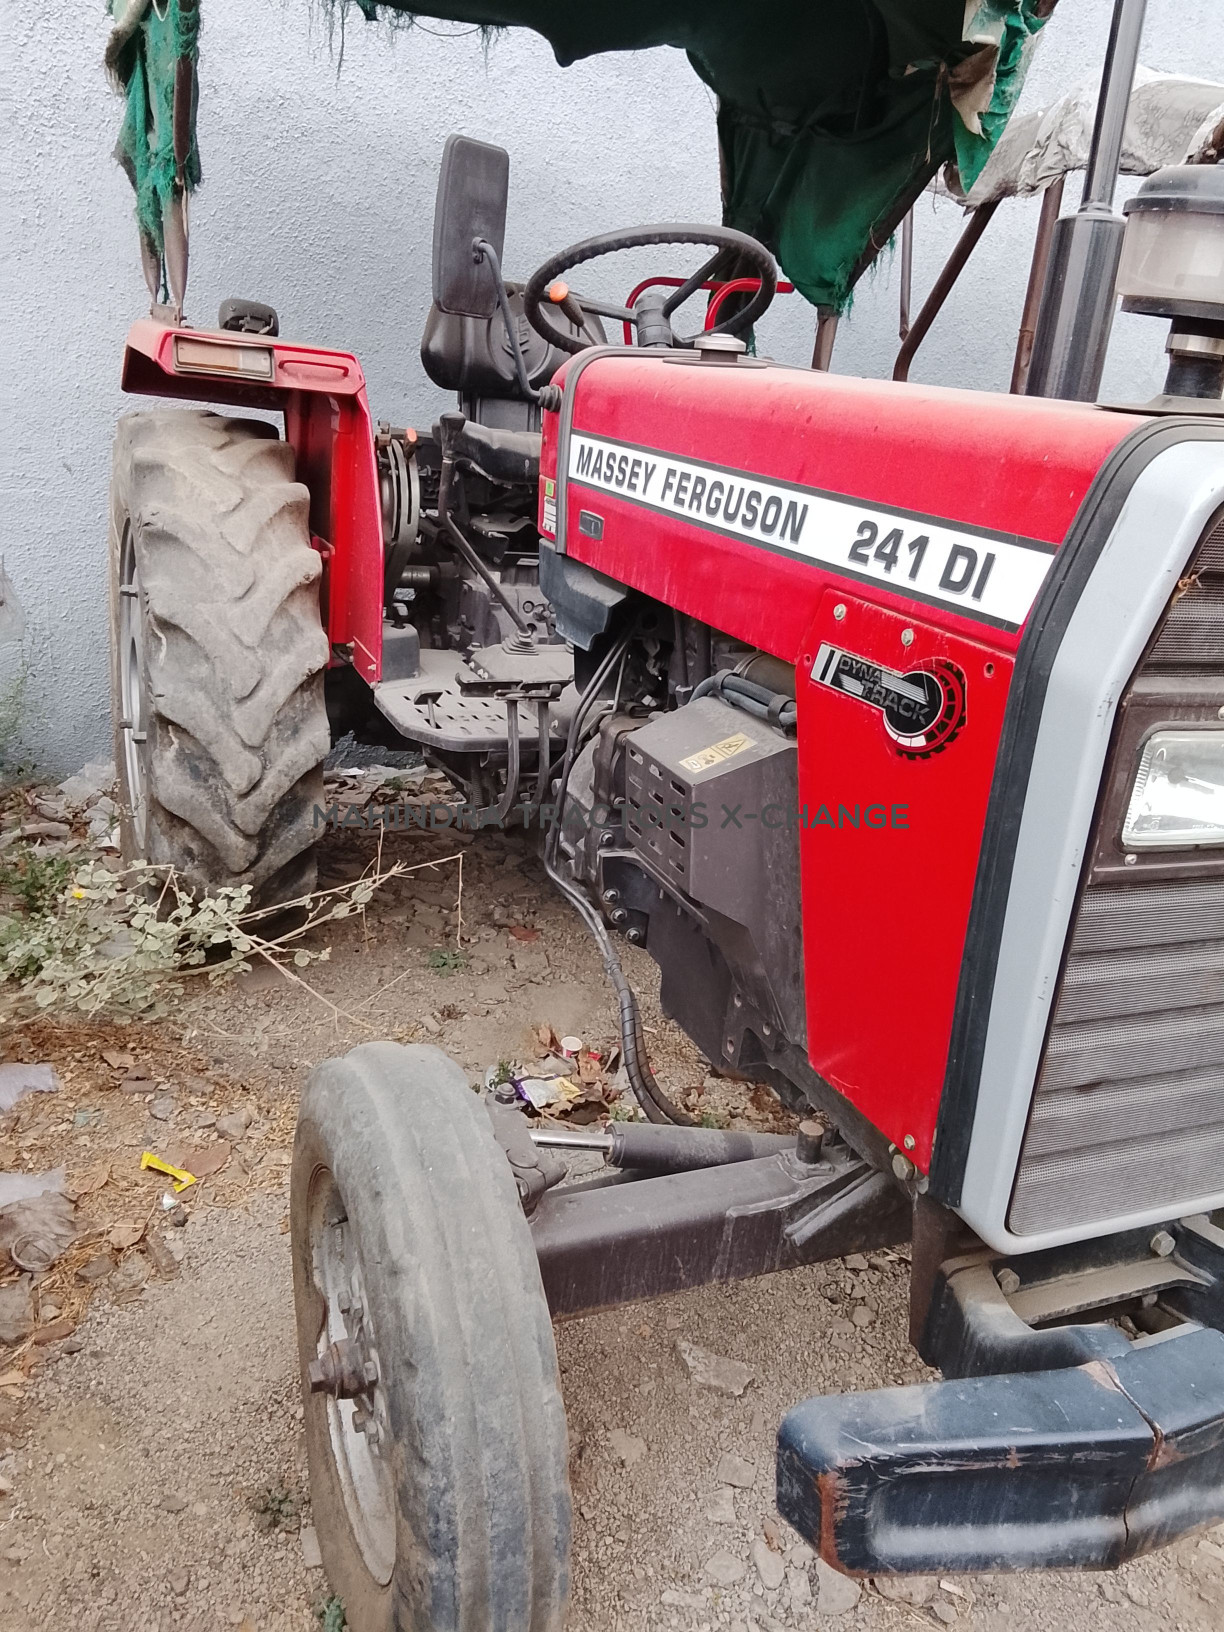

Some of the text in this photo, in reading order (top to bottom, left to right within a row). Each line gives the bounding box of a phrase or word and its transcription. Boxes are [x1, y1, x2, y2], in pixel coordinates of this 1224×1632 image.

[576, 444, 996, 602] MASSEY FERGUSON 241 DI
[838, 655, 882, 686] DYNA
[861, 679, 931, 725] TRACK
